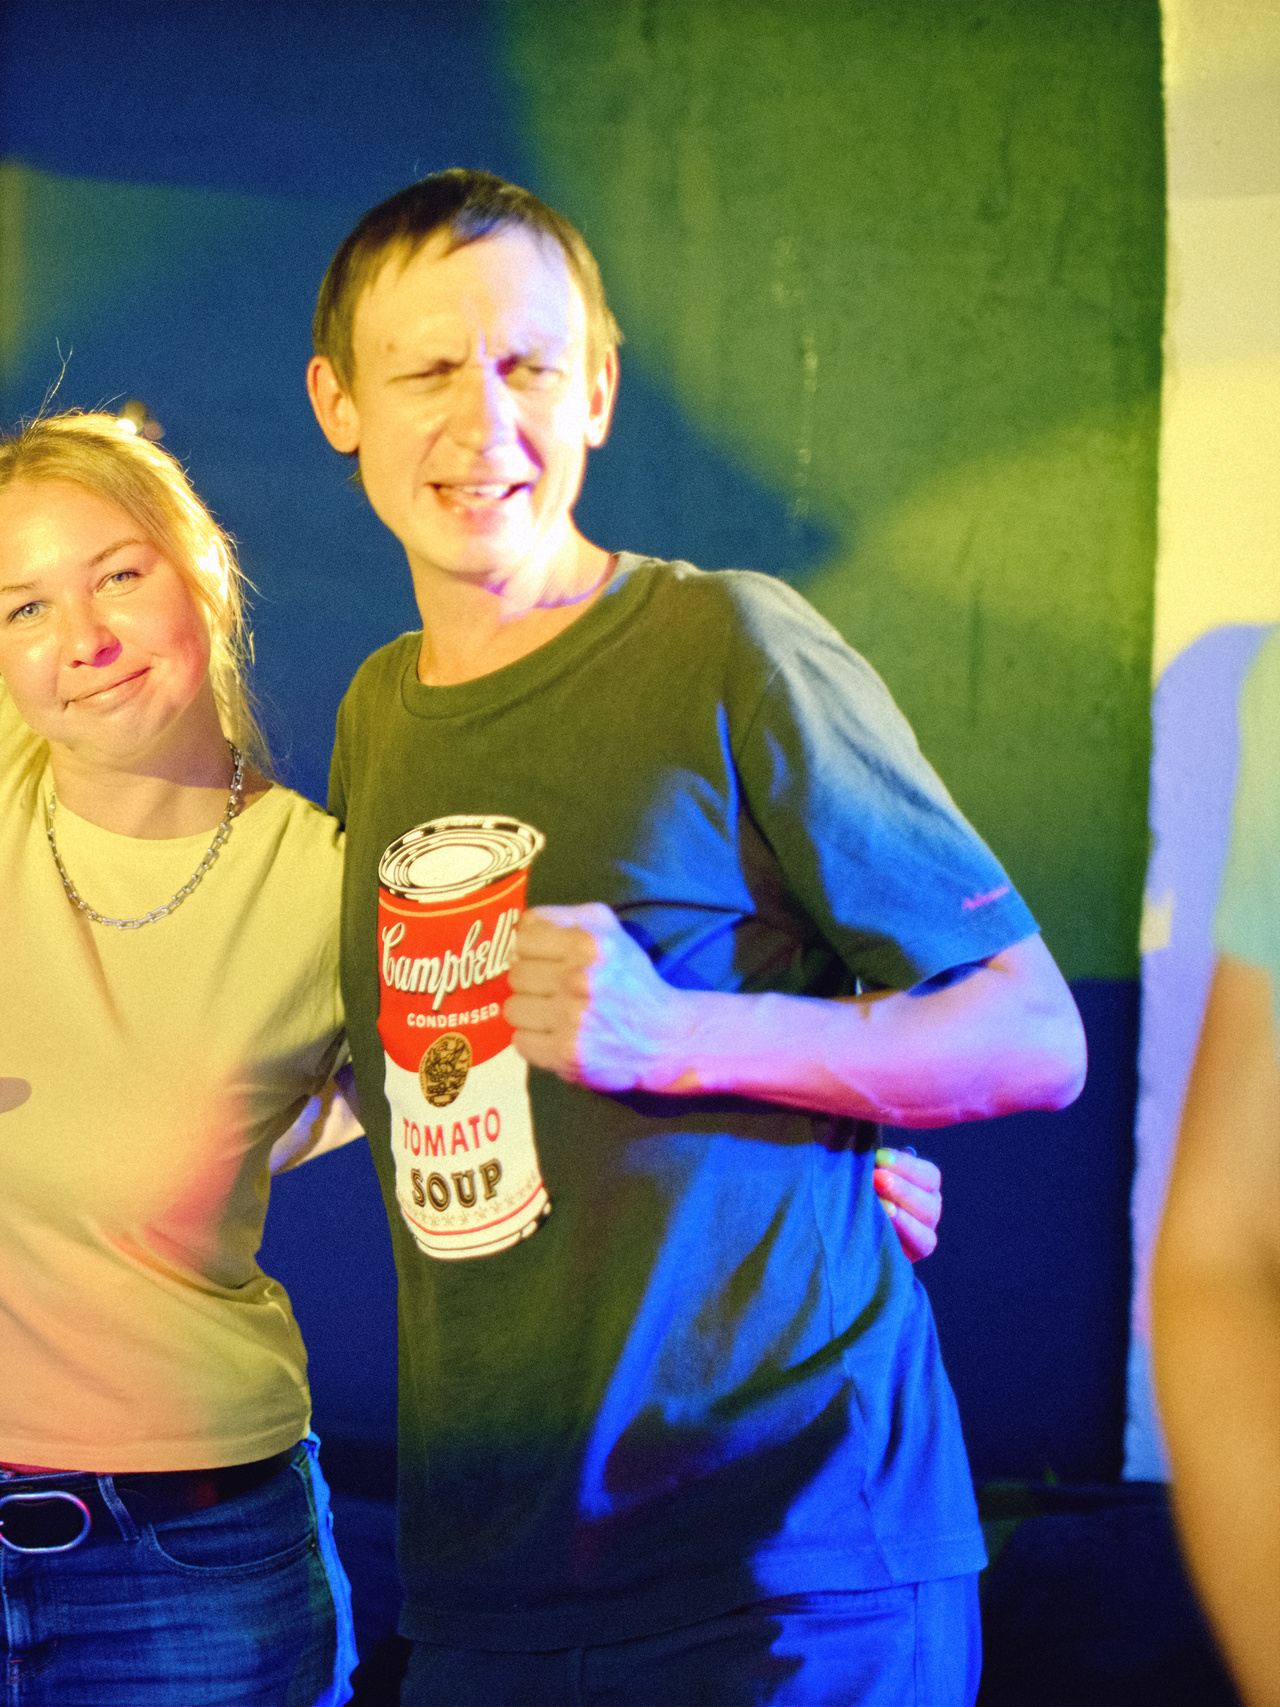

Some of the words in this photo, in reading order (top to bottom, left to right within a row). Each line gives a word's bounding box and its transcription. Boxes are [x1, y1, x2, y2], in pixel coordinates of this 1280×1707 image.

[406, 1002, 500, 1029] CONDENSED
[403, 1106, 501, 1157] TOMATO
[411, 1158, 503, 1212] SOUP
